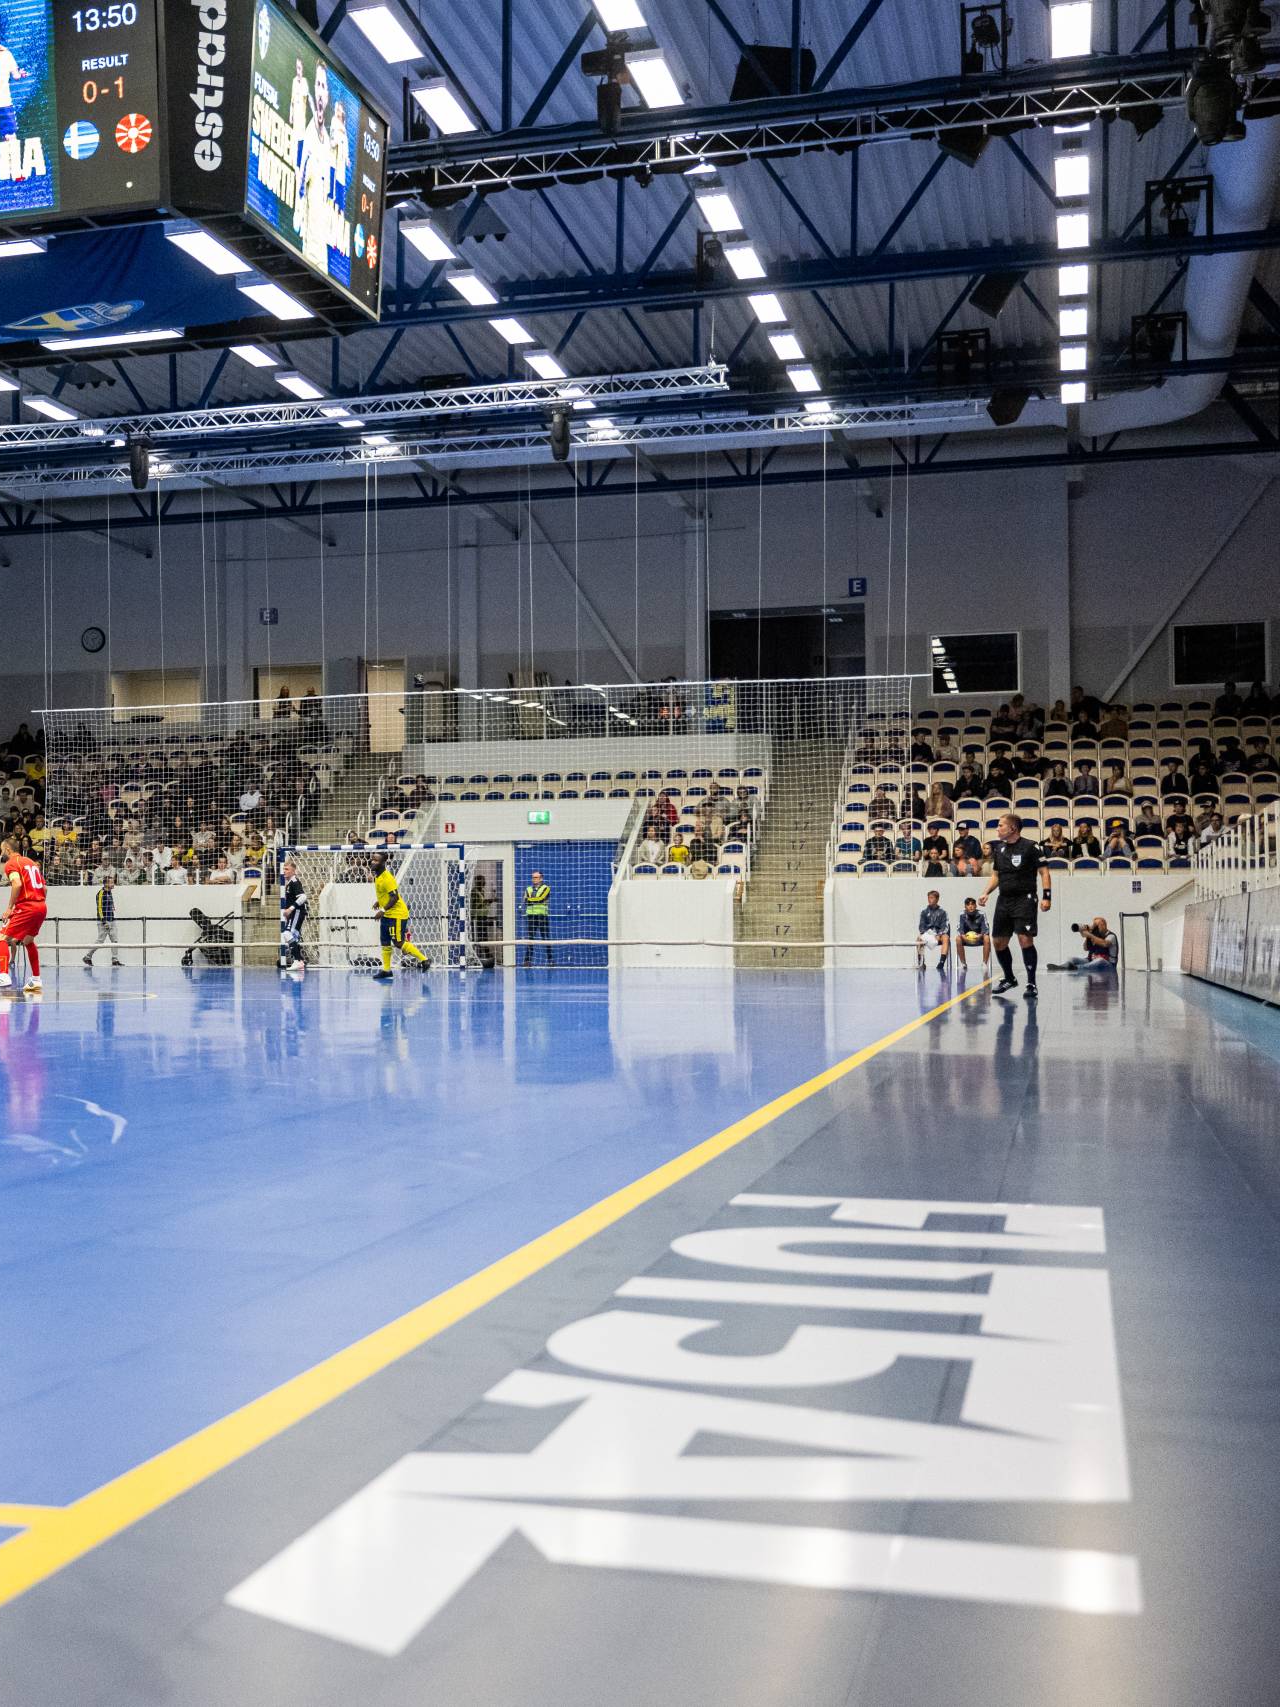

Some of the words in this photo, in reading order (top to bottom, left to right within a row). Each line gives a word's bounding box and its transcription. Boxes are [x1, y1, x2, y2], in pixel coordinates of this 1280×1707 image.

[72, 3, 137, 33] 13:50
[81, 54, 129, 71] RESULT
[852, 580, 862, 593] E
[24, 864, 43, 889] 10
